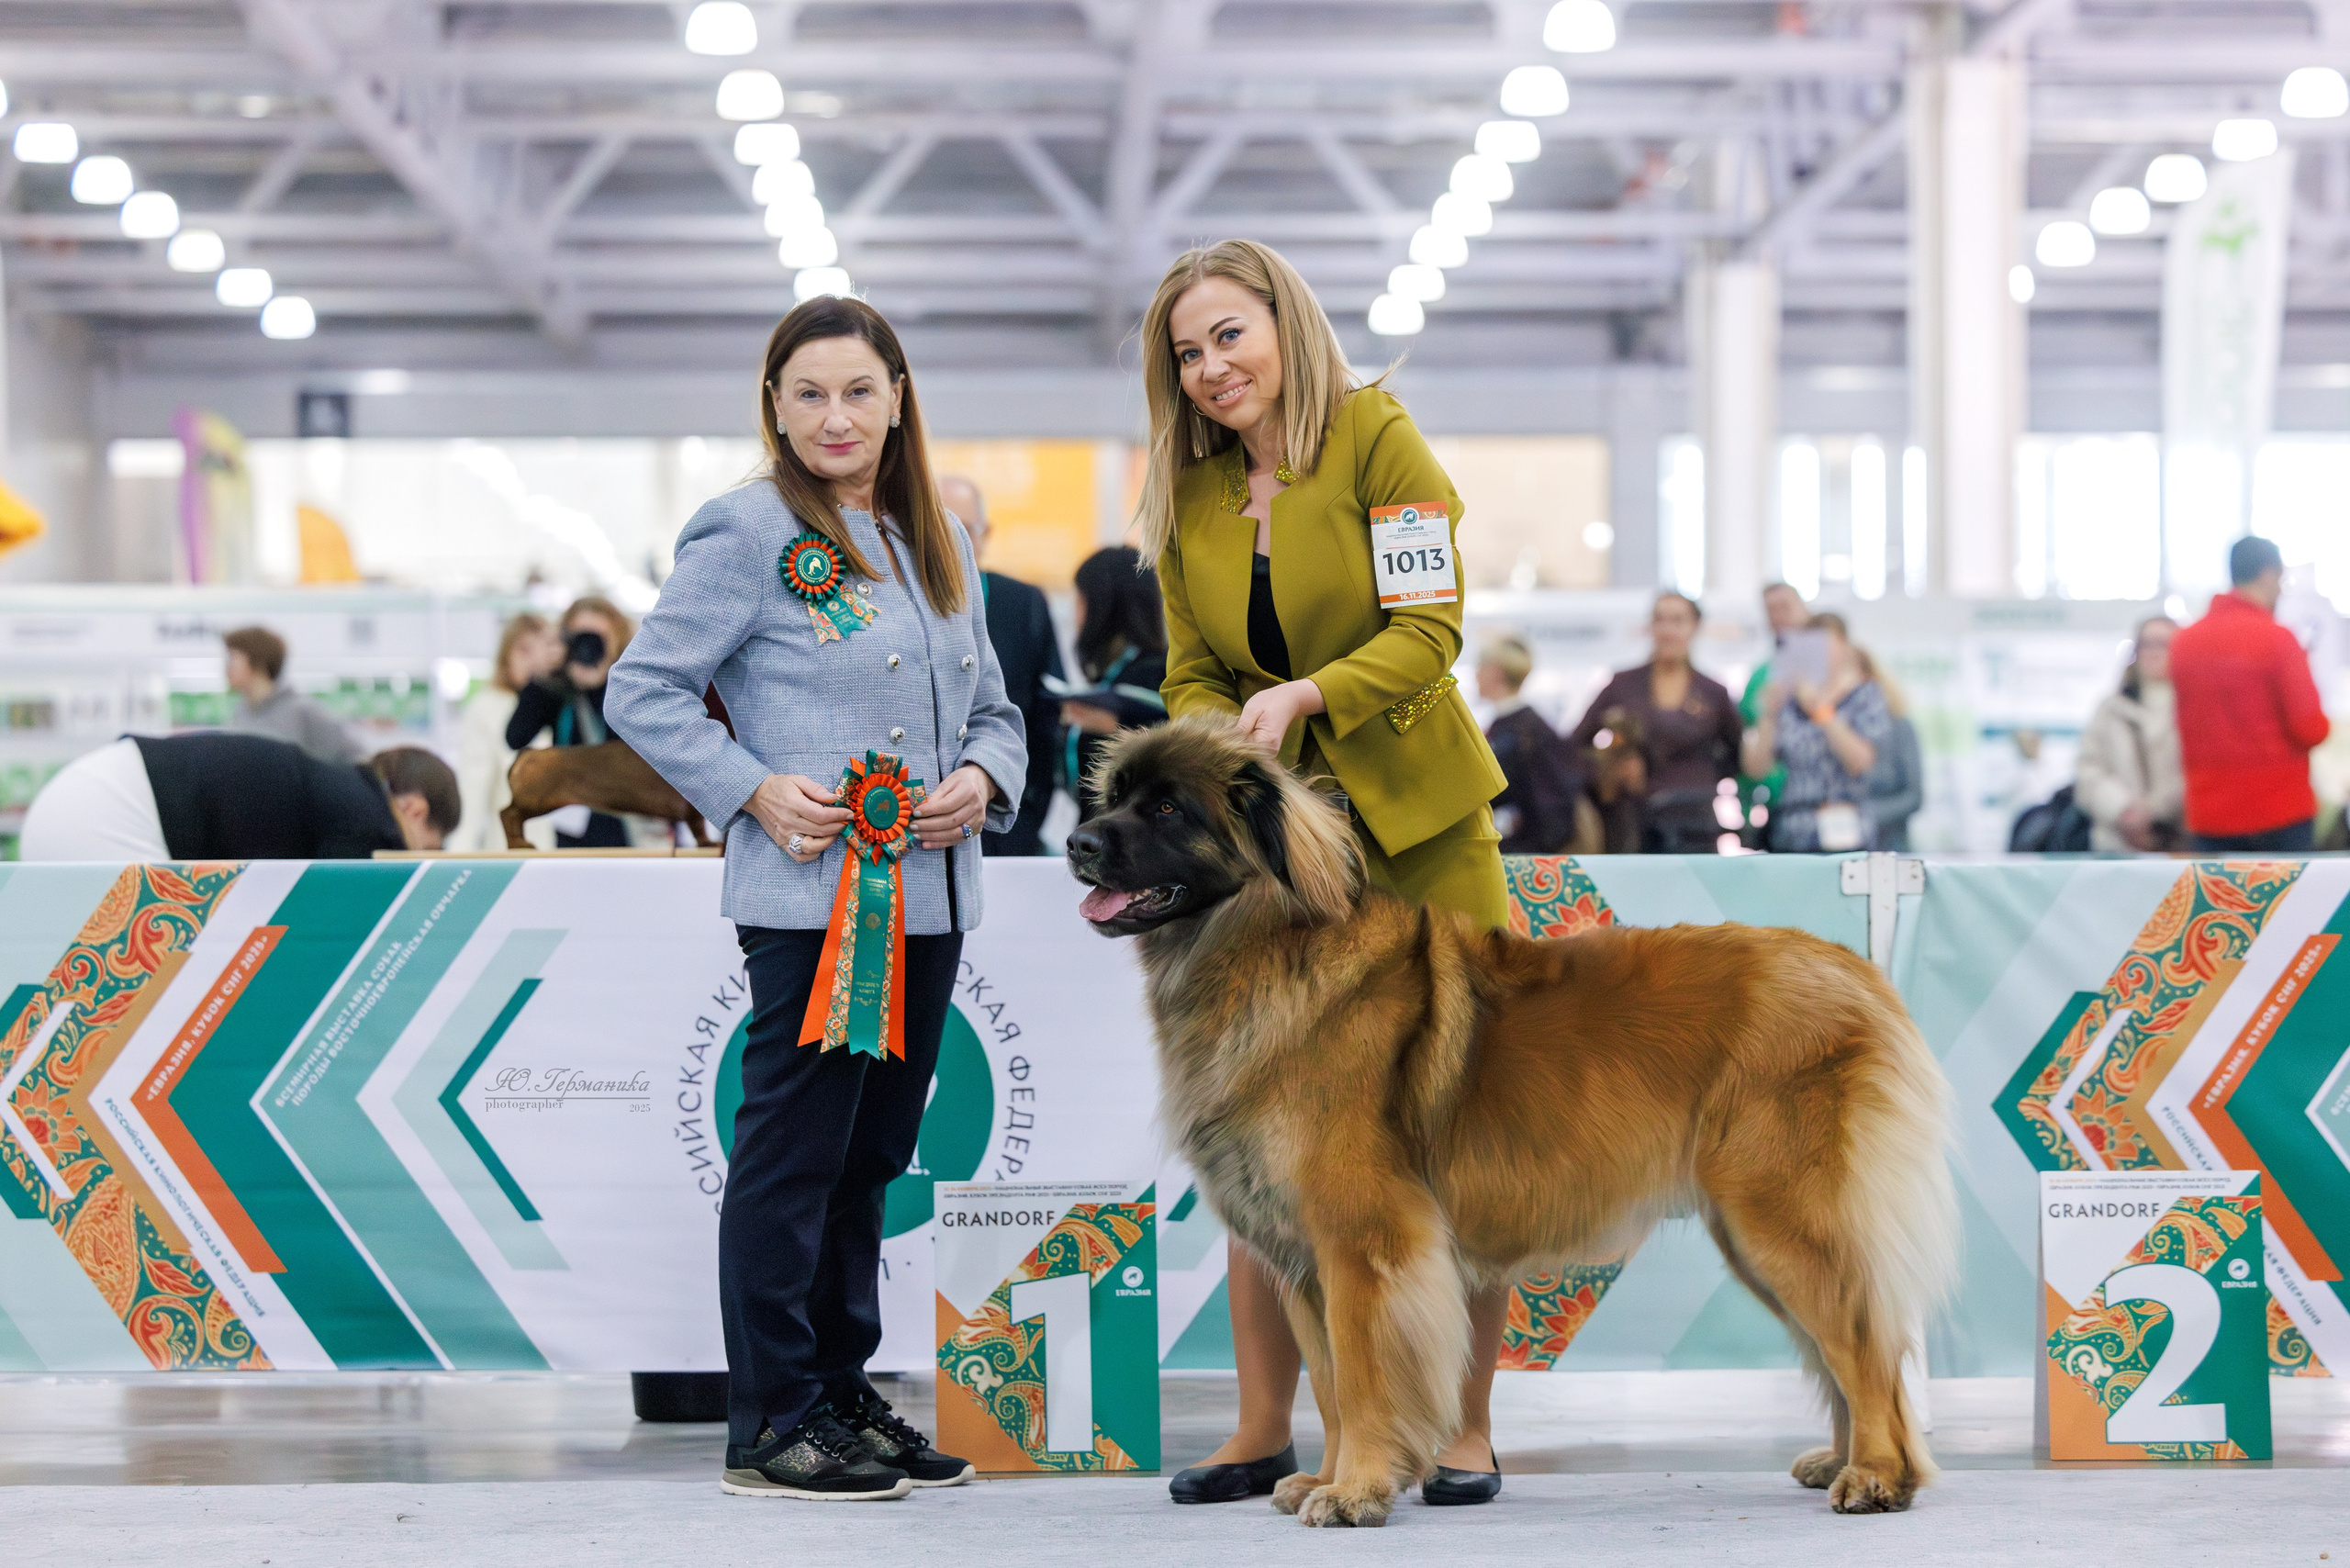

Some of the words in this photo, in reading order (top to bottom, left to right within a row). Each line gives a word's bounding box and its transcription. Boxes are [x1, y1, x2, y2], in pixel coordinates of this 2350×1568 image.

[1382, 548, 1445, 576] 1013
[1397, 525, 1425, 533] ЕВРАЗИЯ
[1399, 590, 1436, 601] 16.11.2025
[191, 995, 225, 1038] КУБОК
[221, 969, 243, 997] СНГ
[291, 1058, 331, 1107] ПОРОДЫ
[430, 869, 473, 921] ОВЧАРКА
[2245, 1003, 2281, 1047] КУБОК
[2275, 975, 2298, 1004] СНГ
[275, 1039, 328, 1108] ВСЕМИРНАЯ
[324, 980, 373, 1041] ВЫСТАВКА
[371, 940, 402, 981] СОБАК
[105, 1097, 156, 1165] РОССИЙСКАЯ
[220, 1255, 265, 1318] ФЕДЕРАЦИЯ
[942, 1210, 1056, 1227] GRANDORF
[2048, 1203, 2160, 1218] GRANDORF
[1011, 1272, 1094, 1453] 1
[2104, 1262, 2228, 1444] 2
